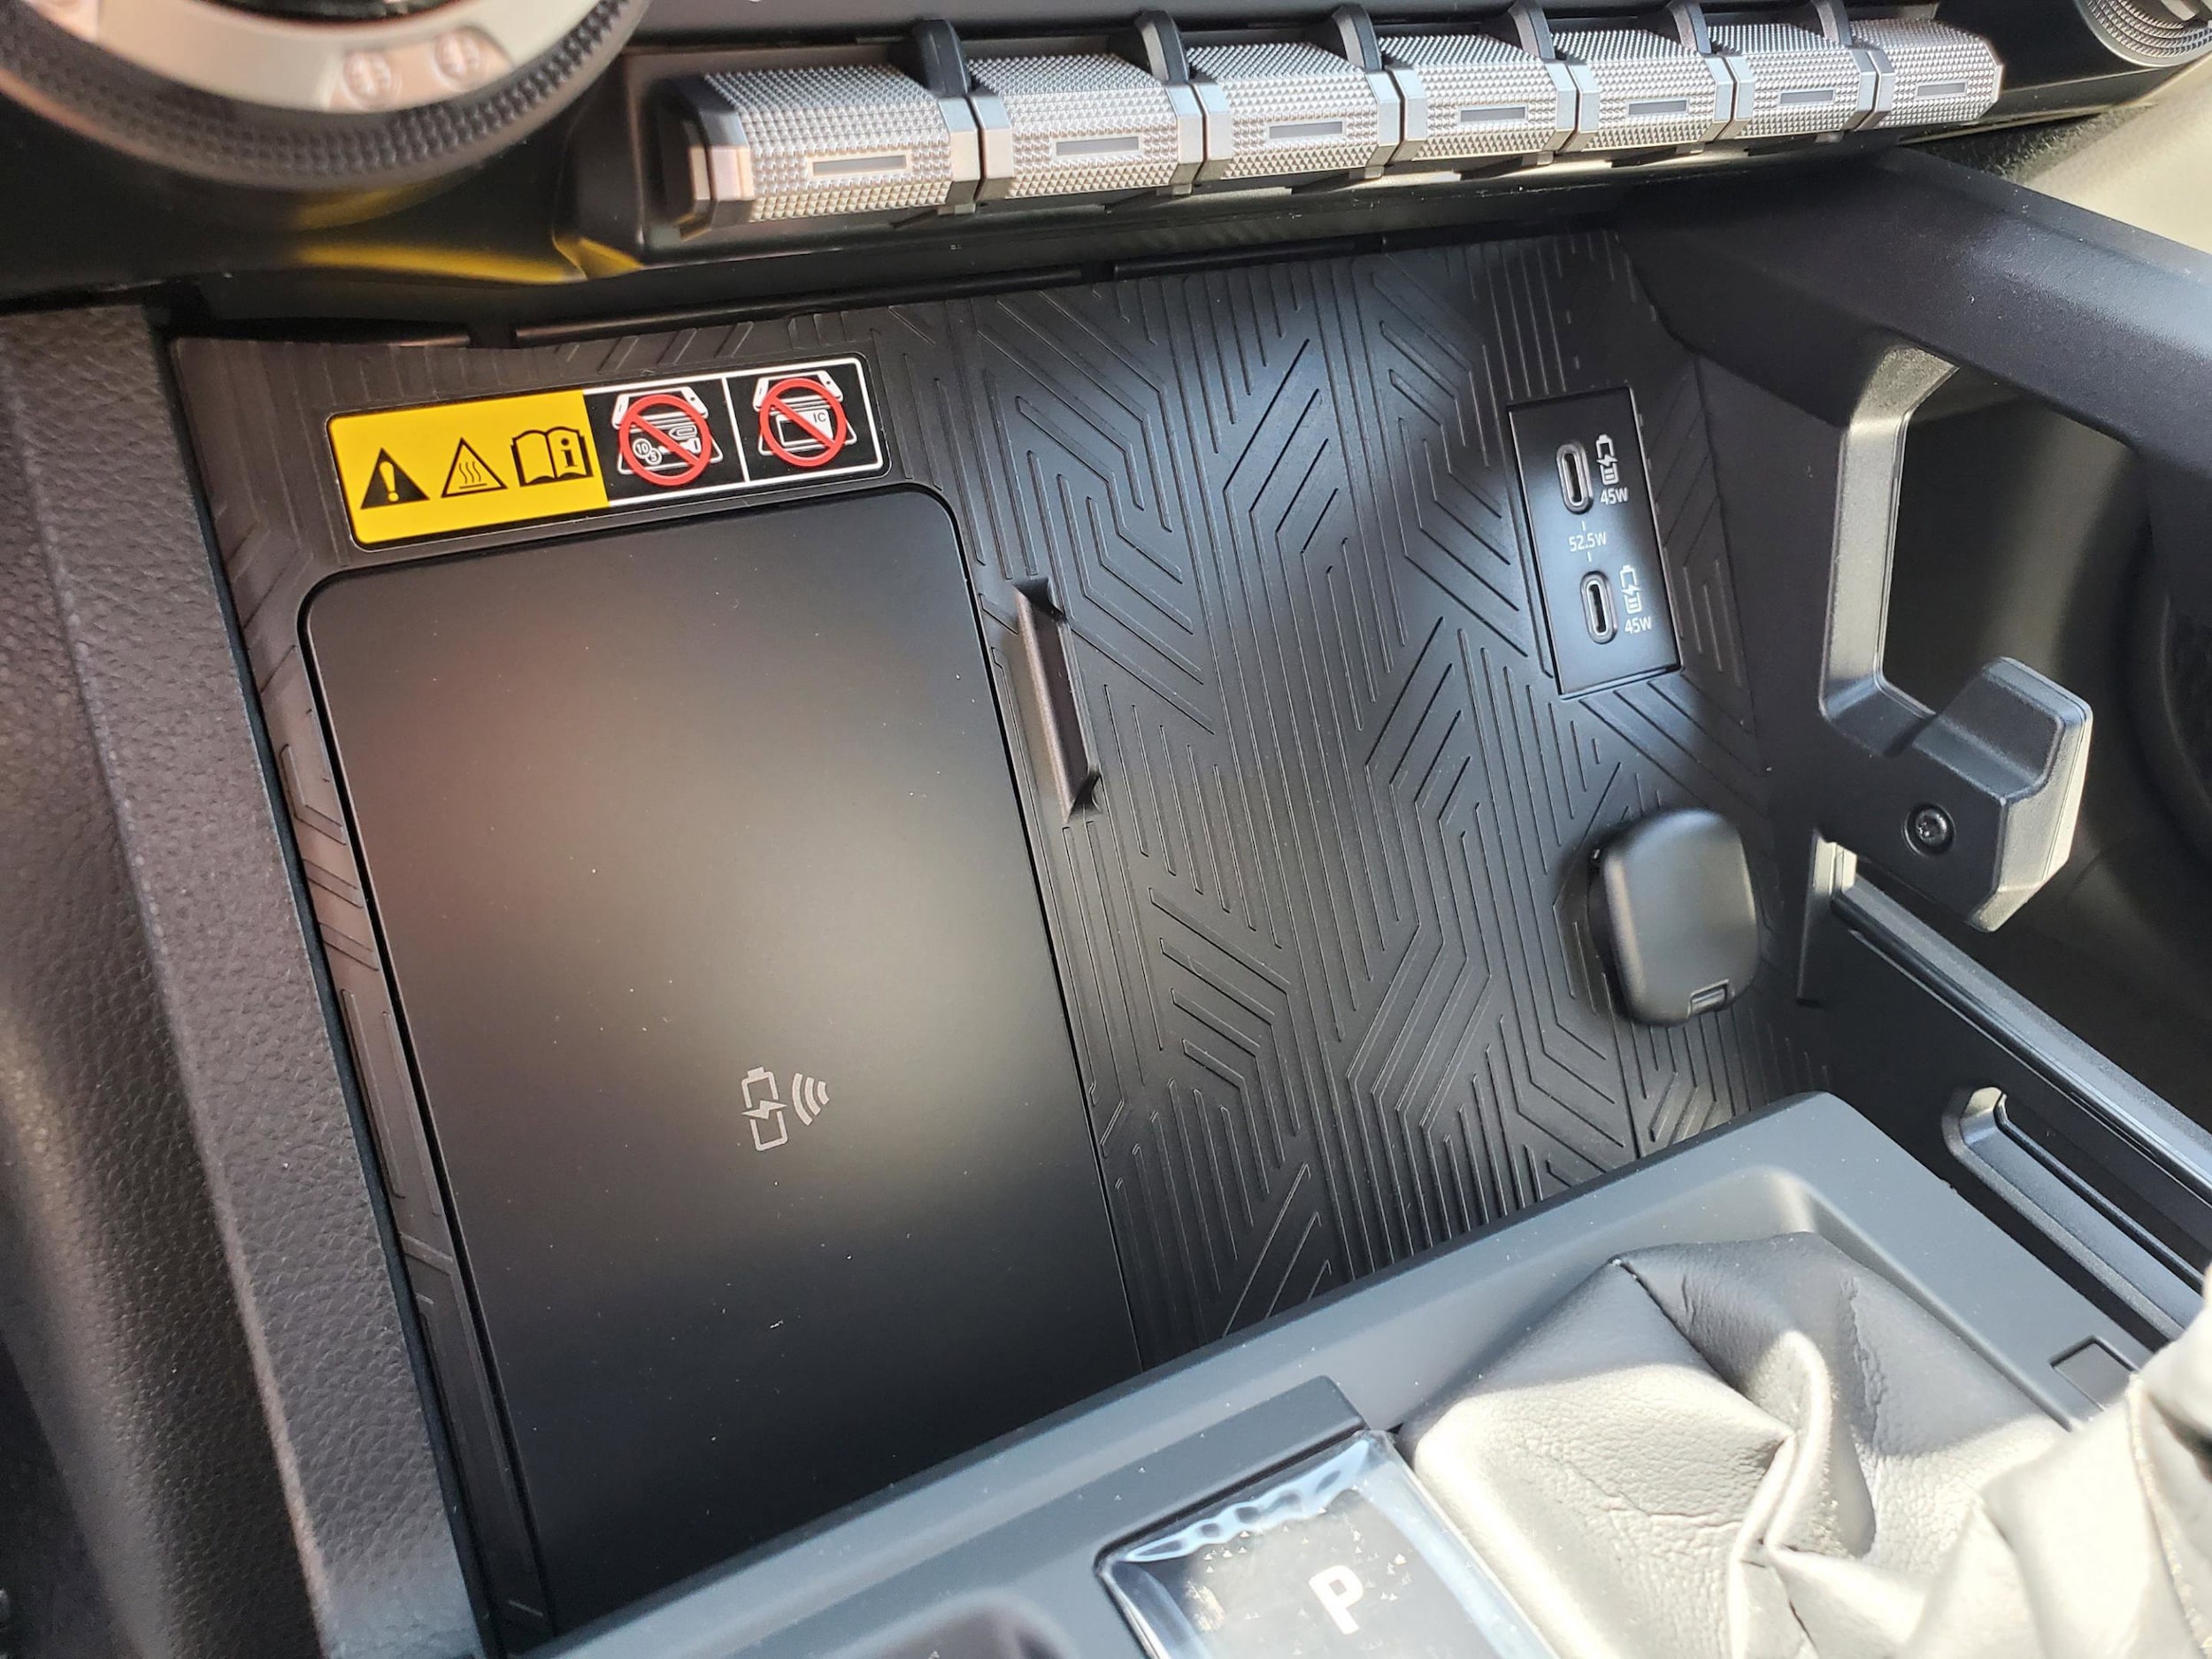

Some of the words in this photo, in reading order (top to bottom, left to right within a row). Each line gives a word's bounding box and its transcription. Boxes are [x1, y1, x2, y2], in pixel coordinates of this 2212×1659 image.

[813, 411, 826, 423] IC
[636, 443, 649, 454] 10
[1600, 487, 1629, 505] 45W
[1569, 533, 1607, 552] 52.5W
[1624, 618, 1652, 634] 45W
[1309, 1564, 1363, 1634] P
